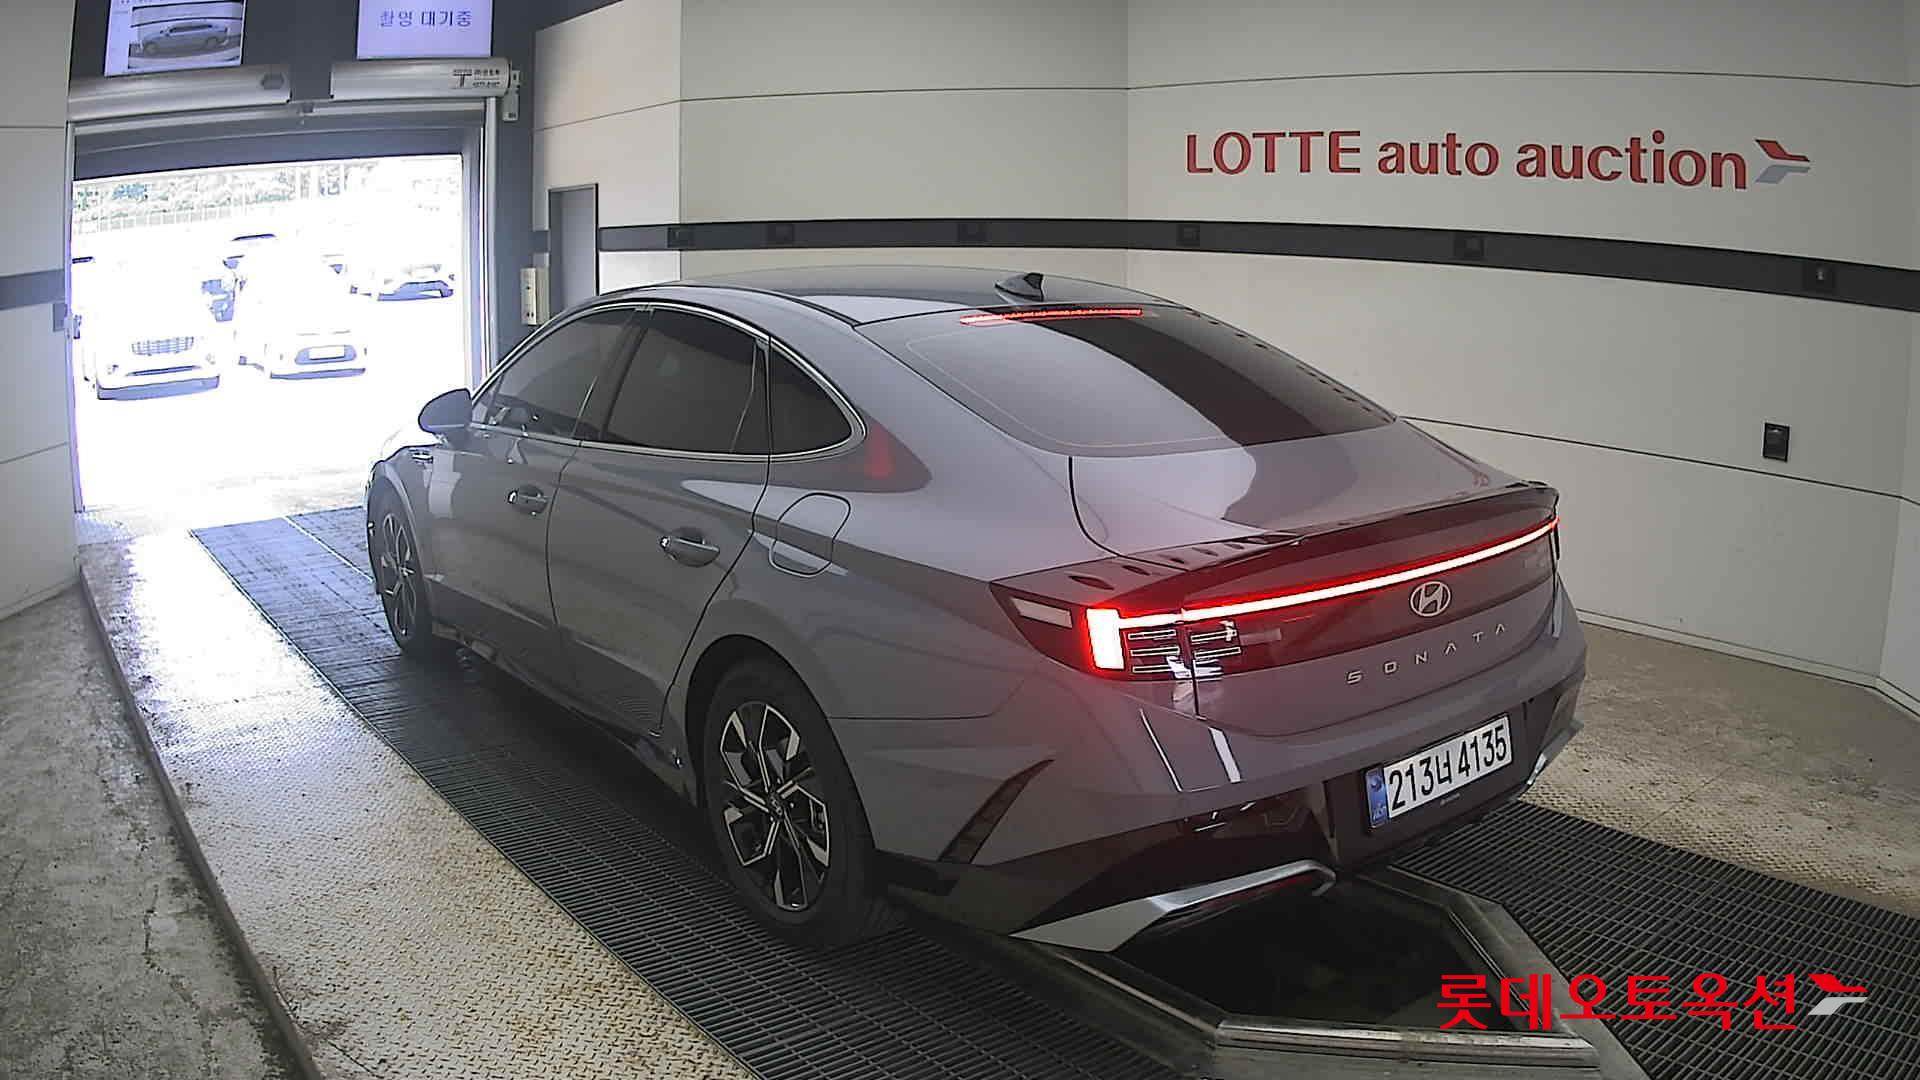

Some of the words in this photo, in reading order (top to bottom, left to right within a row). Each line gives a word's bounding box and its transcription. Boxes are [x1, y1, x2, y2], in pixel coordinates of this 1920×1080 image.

[421, 10, 472, 28] 대기중
[1186, 131, 1361, 175] LOTTE
[1377, 133, 1500, 177] auto
[1516, 130, 1748, 190] auction
[1346, 623, 1506, 684] SONATA
[1389, 750, 1453, 811] 213너
[1457, 724, 1507, 777] 4135
